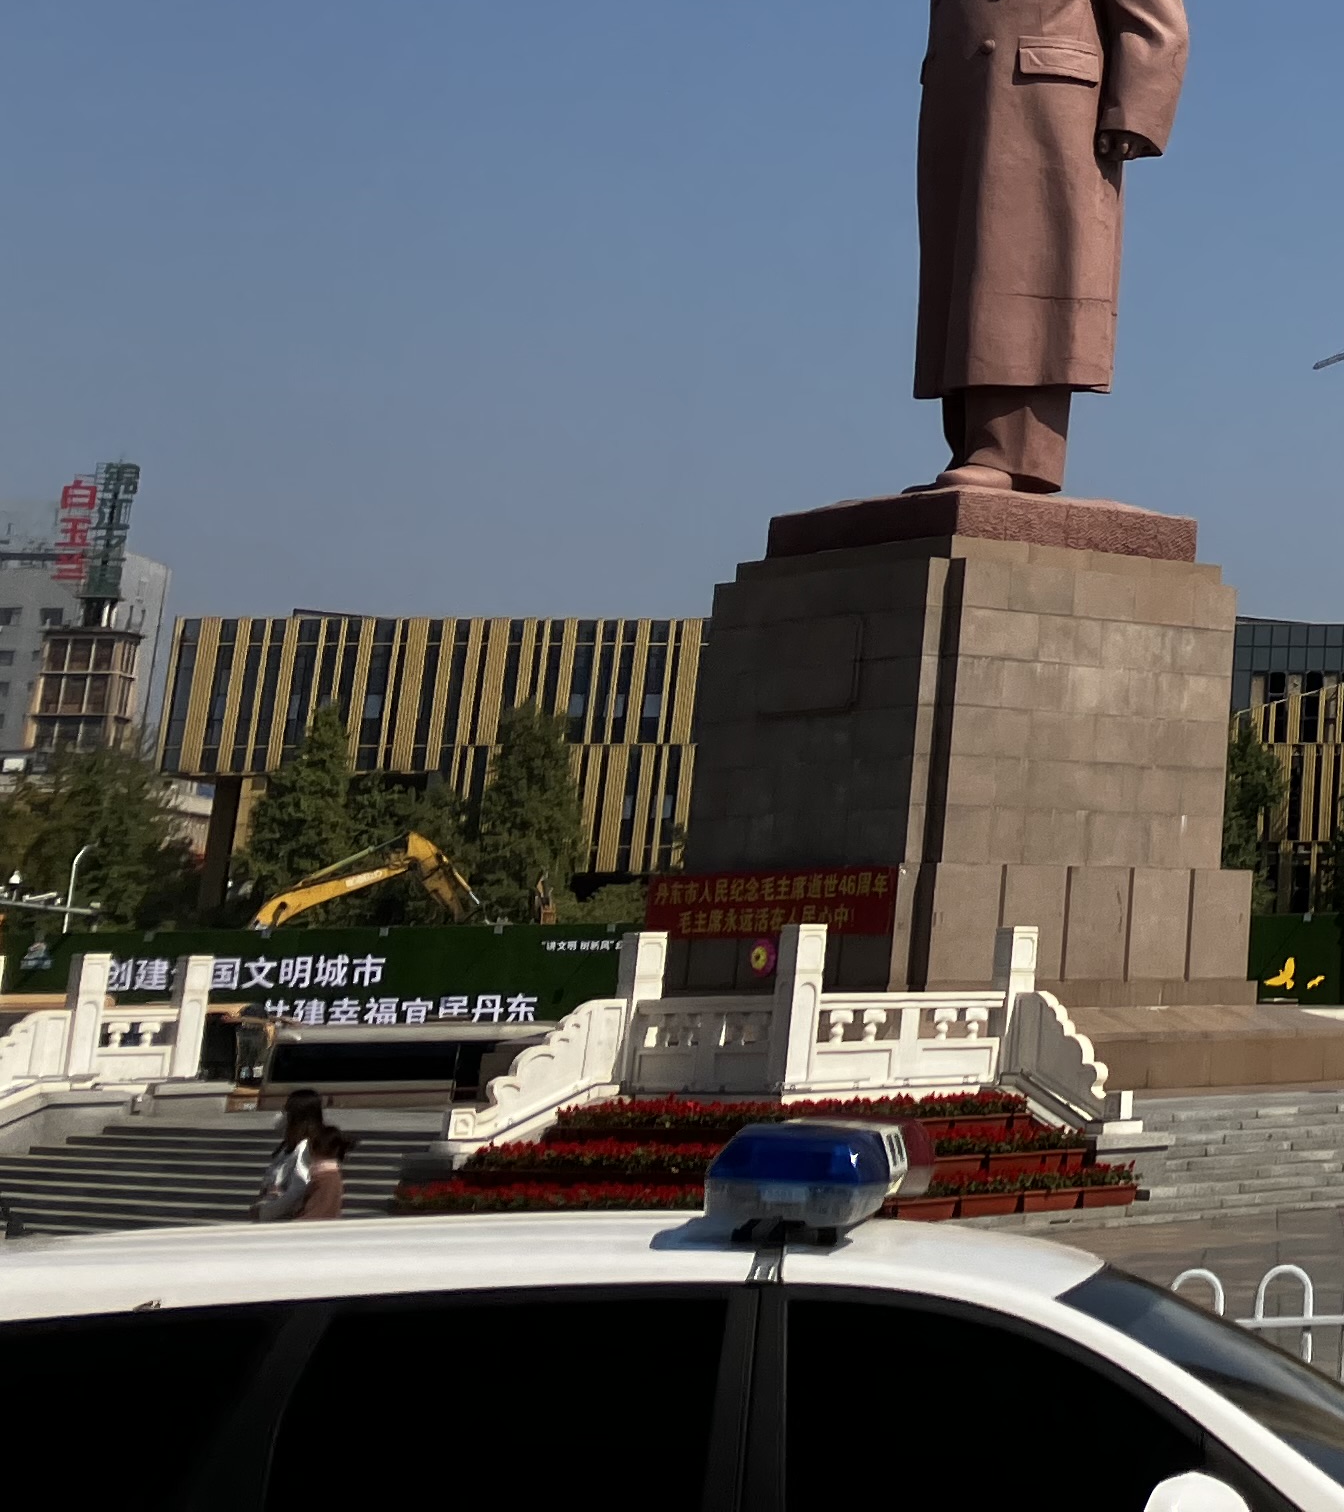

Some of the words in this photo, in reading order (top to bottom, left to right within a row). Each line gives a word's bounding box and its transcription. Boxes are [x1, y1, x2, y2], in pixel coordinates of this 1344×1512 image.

[51, 479, 98, 581] 白玉兰
[654, 872, 889, 906] 丹东市人民纪念毛主席逝世46周年
[109, 954, 387, 991] 创建国文明城市
